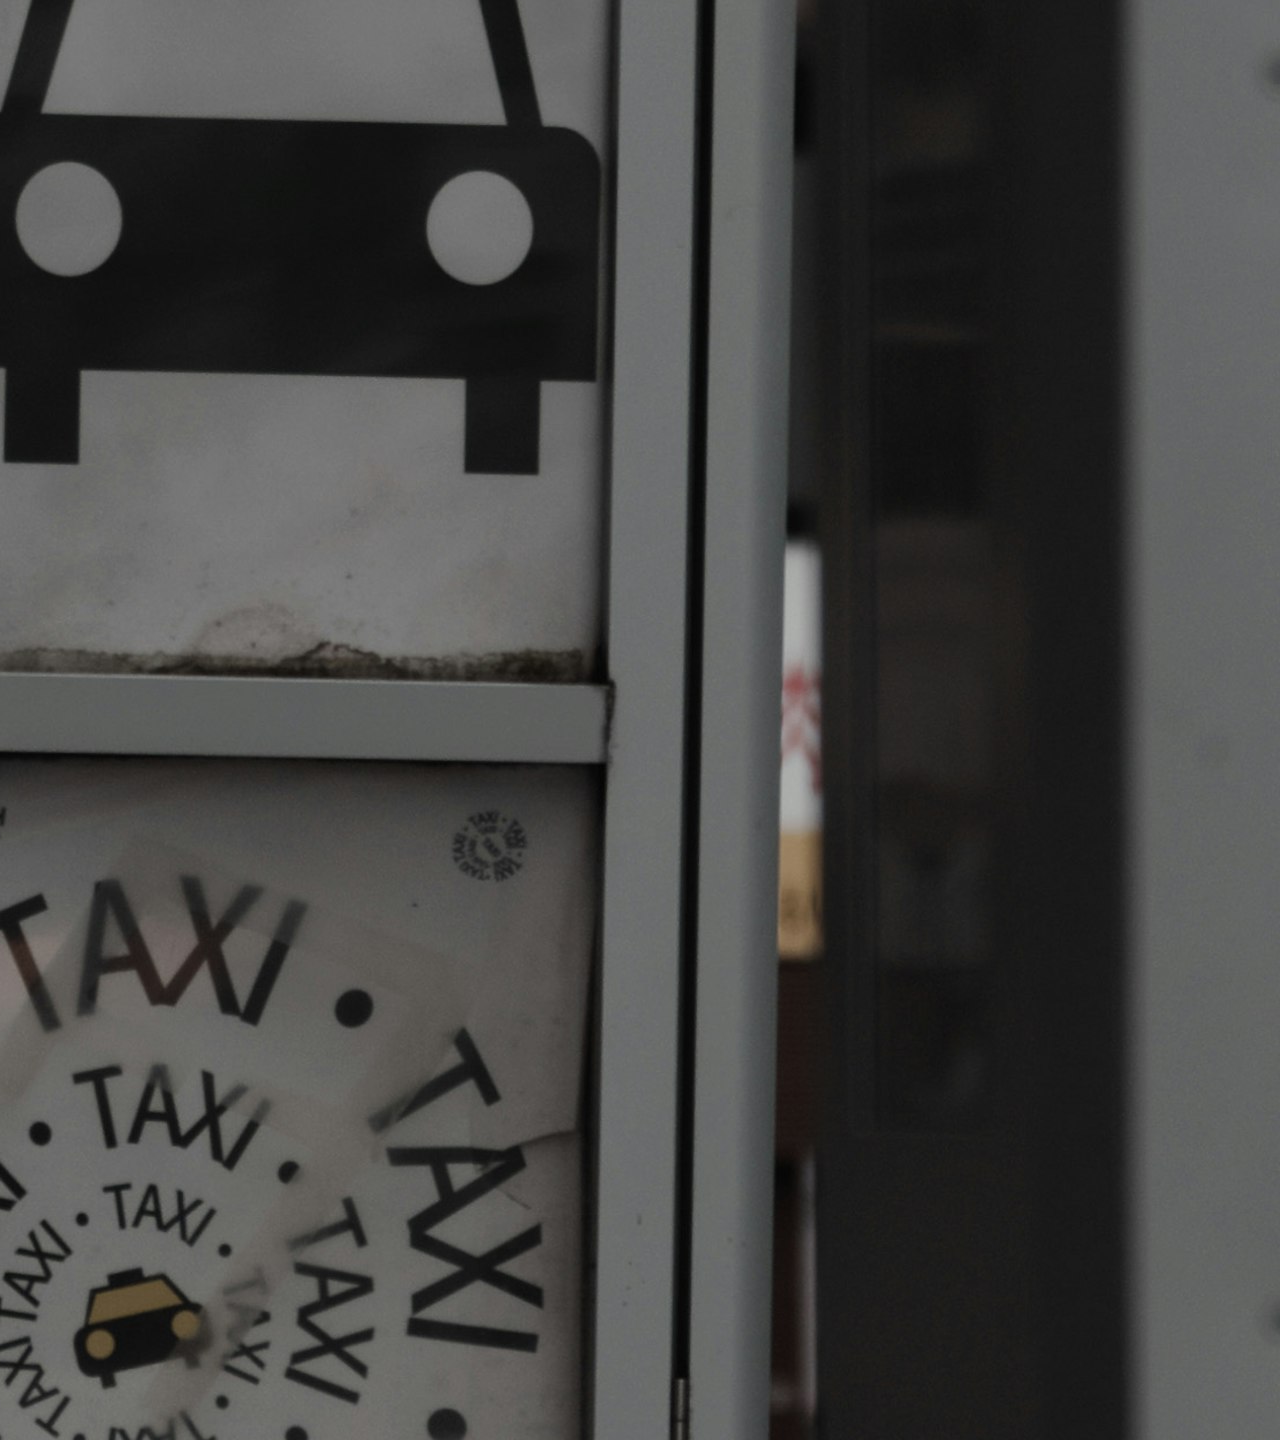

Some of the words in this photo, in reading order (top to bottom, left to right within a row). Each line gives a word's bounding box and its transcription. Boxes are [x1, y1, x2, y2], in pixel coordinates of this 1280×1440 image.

[73, 1064, 273, 1170] TAXI
[285, 1196, 375, 1406] TAXI
[102, 1182, 217, 1247] TAXI
[369, 1027, 543, 1353] TAXI
